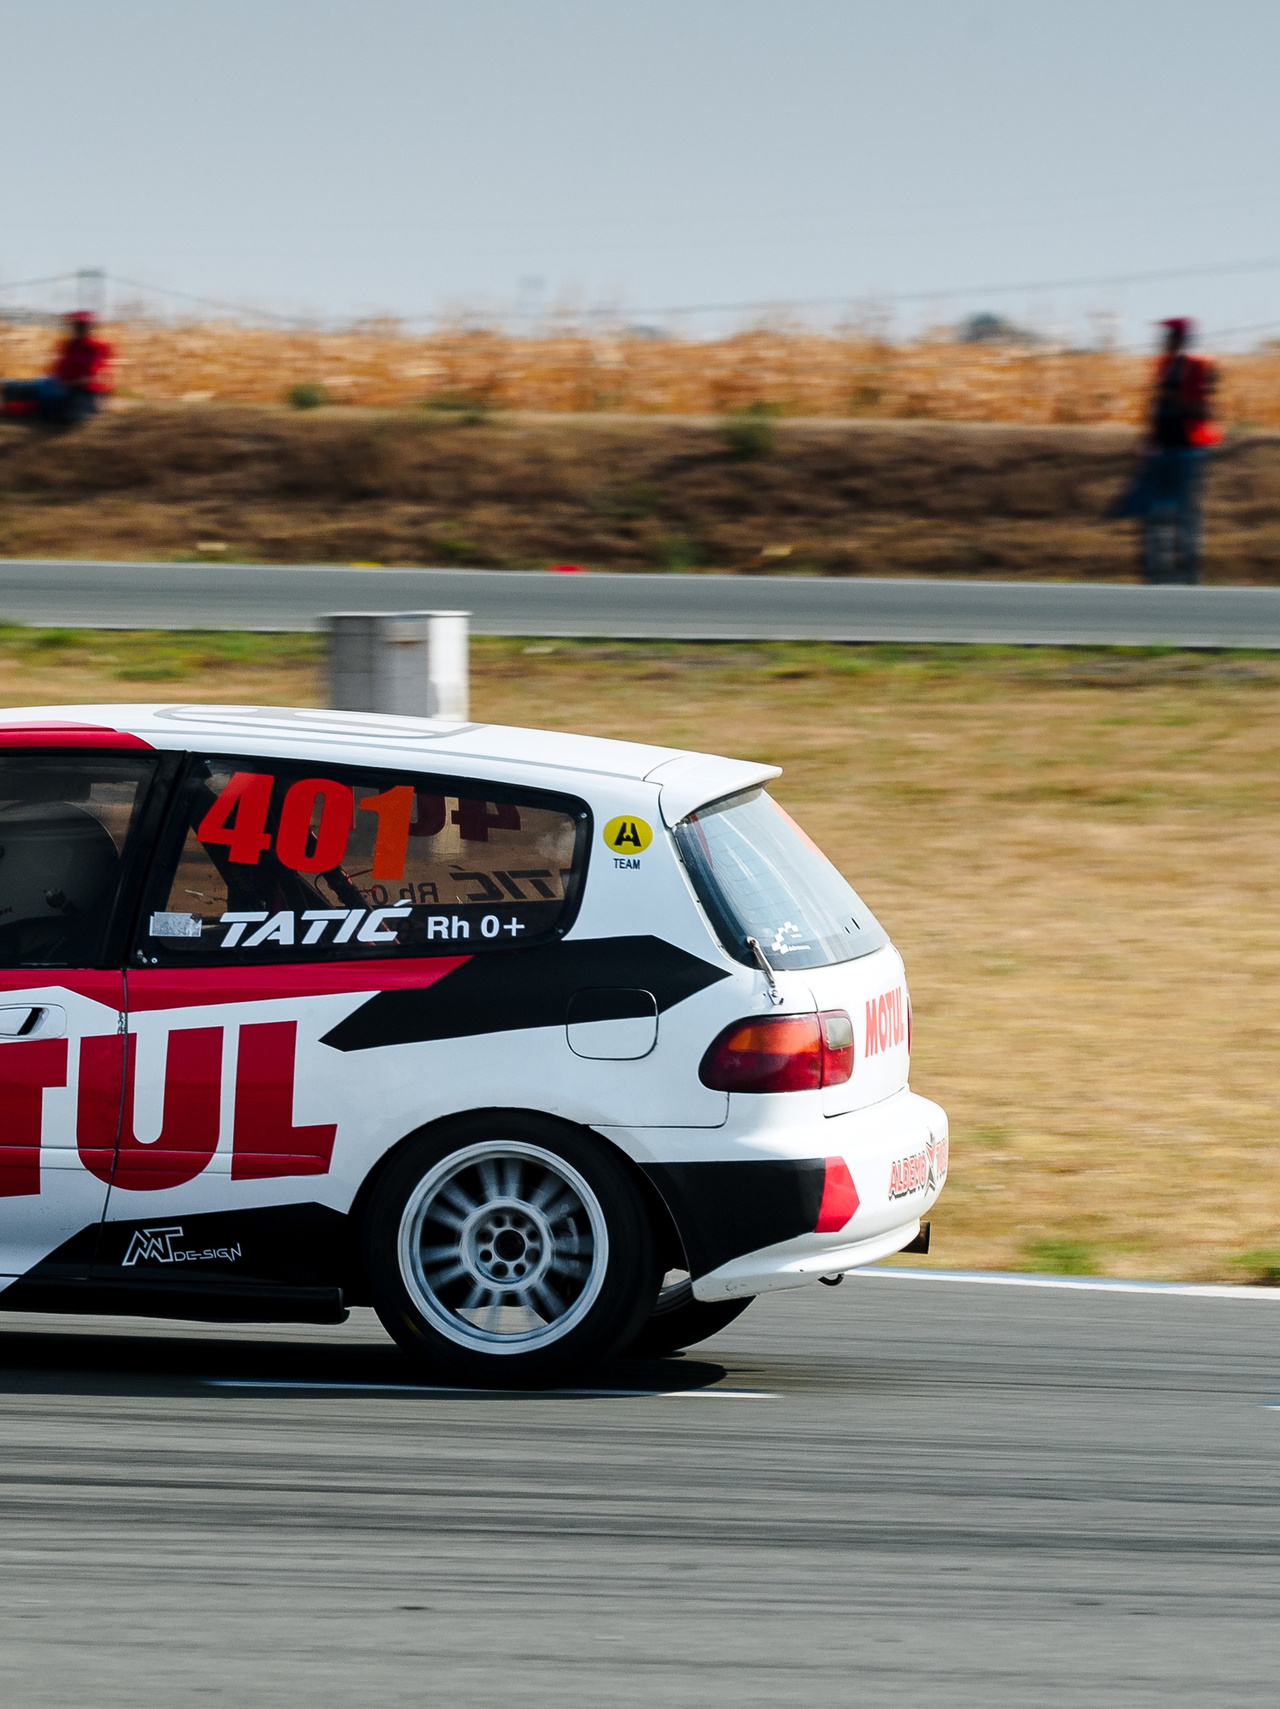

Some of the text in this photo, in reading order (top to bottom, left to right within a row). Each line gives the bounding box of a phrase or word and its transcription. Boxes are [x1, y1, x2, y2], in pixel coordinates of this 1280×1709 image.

[196, 771, 414, 881] 401
[613, 858, 641, 870] TEAM
[220, 899, 413, 947] TATIĆ
[427, 915, 470, 939] Rh
[865, 986, 905, 1058] MOTUL
